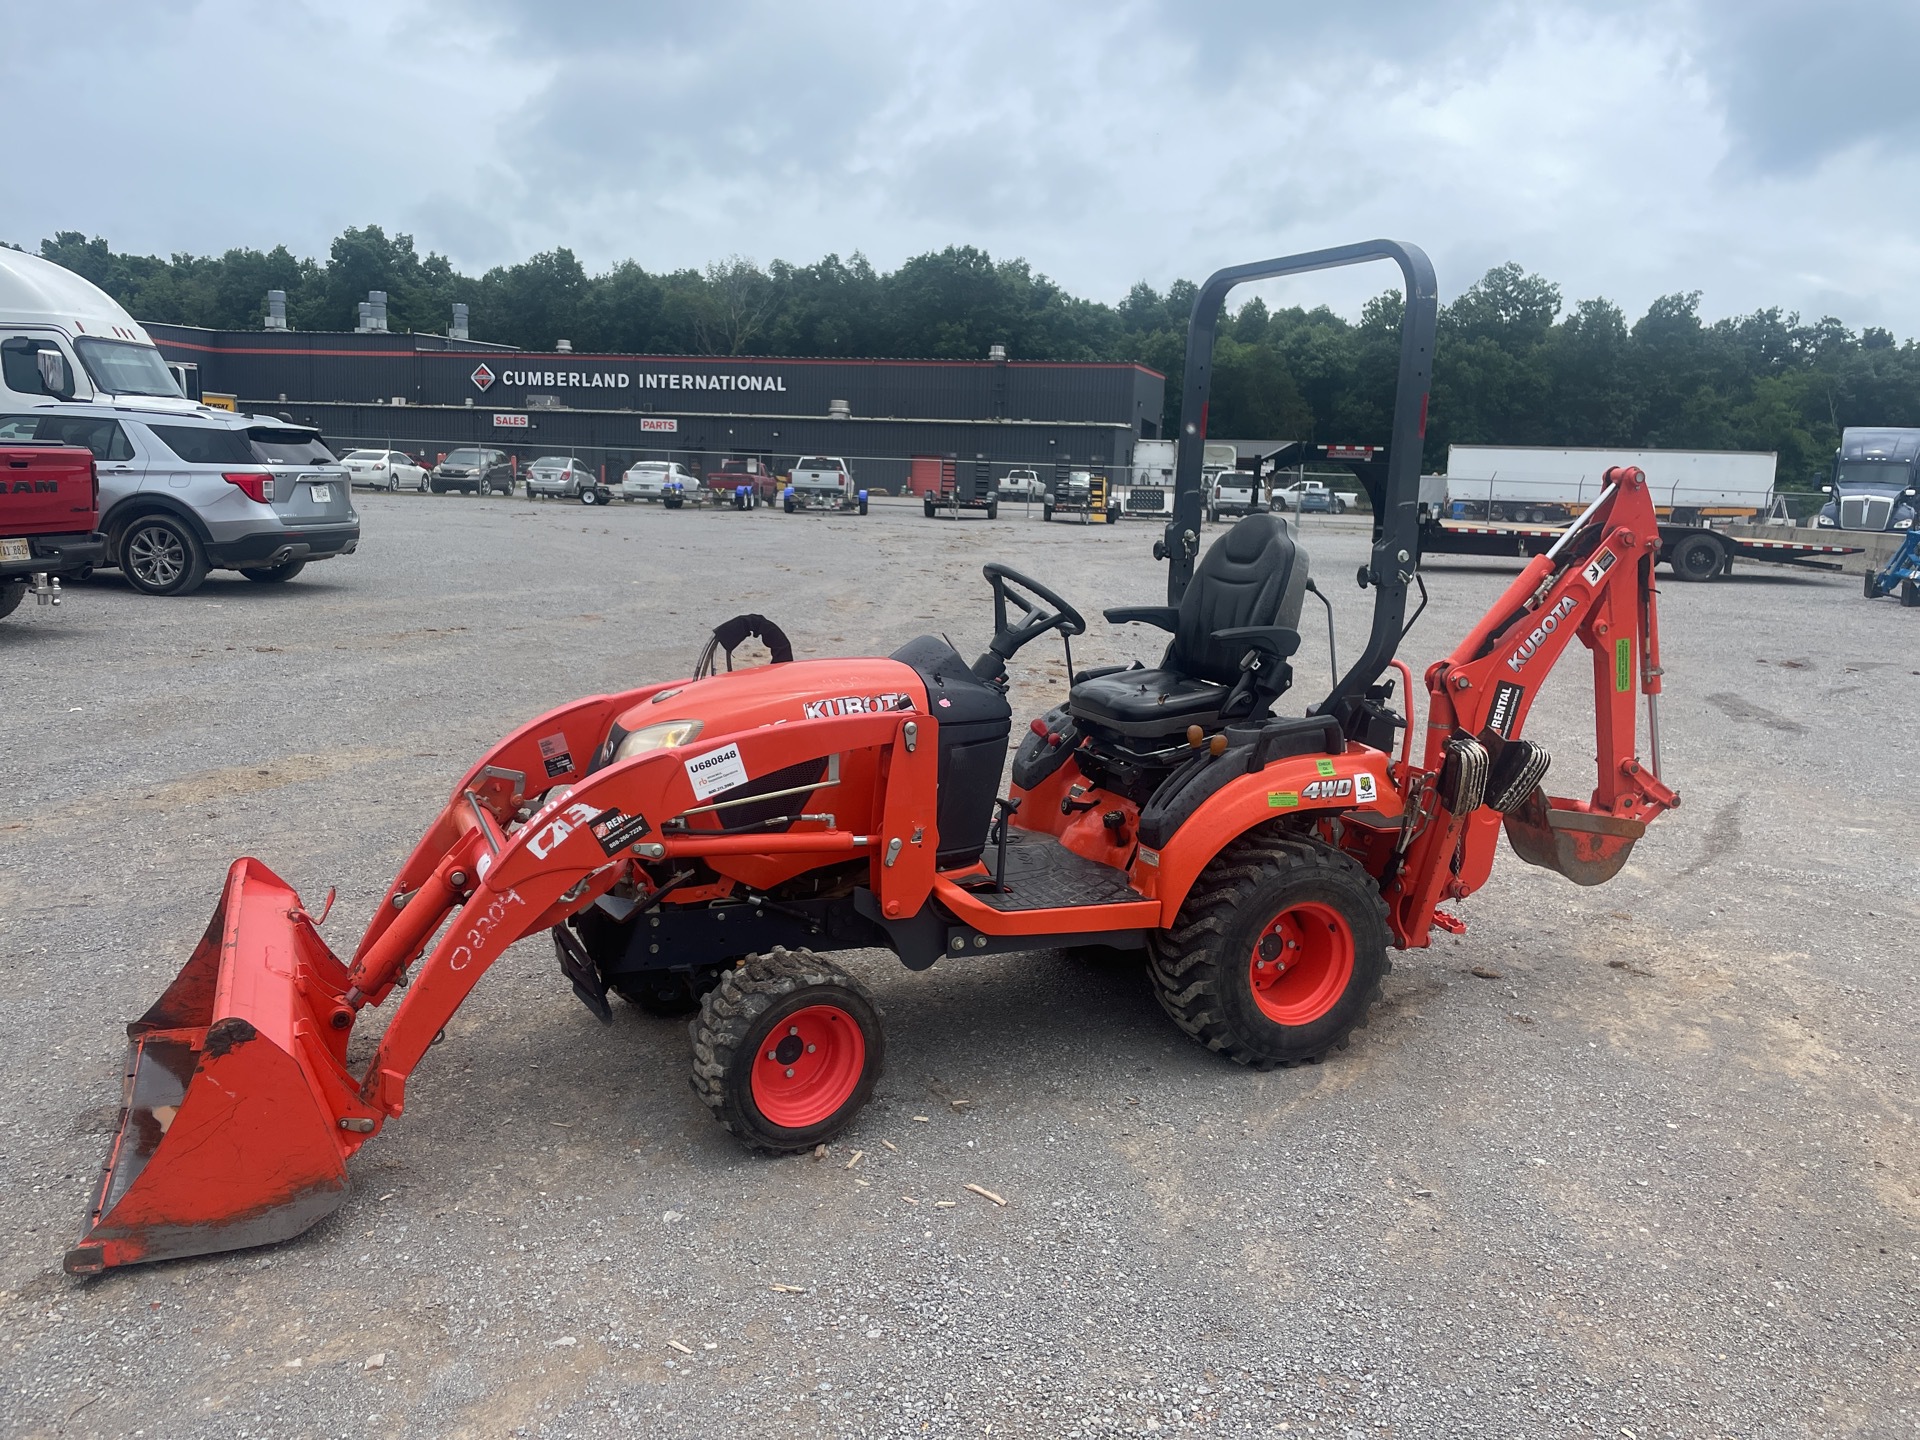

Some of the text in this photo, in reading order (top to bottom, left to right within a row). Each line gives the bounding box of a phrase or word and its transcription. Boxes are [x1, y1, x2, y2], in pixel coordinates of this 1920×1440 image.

[502, 370, 787, 392] CUMBERLAND INTERNATIONAL
[495, 416, 526, 426] SALES
[642, 420, 675, 430] PARTS
[1507, 595, 1579, 673] KUBOTA
[1491, 687, 1513, 729] RENTAL
[690, 750, 737, 773] U680848
[1301, 777, 1353, 800] 4WD
[517, 789, 574, 840] 2204
